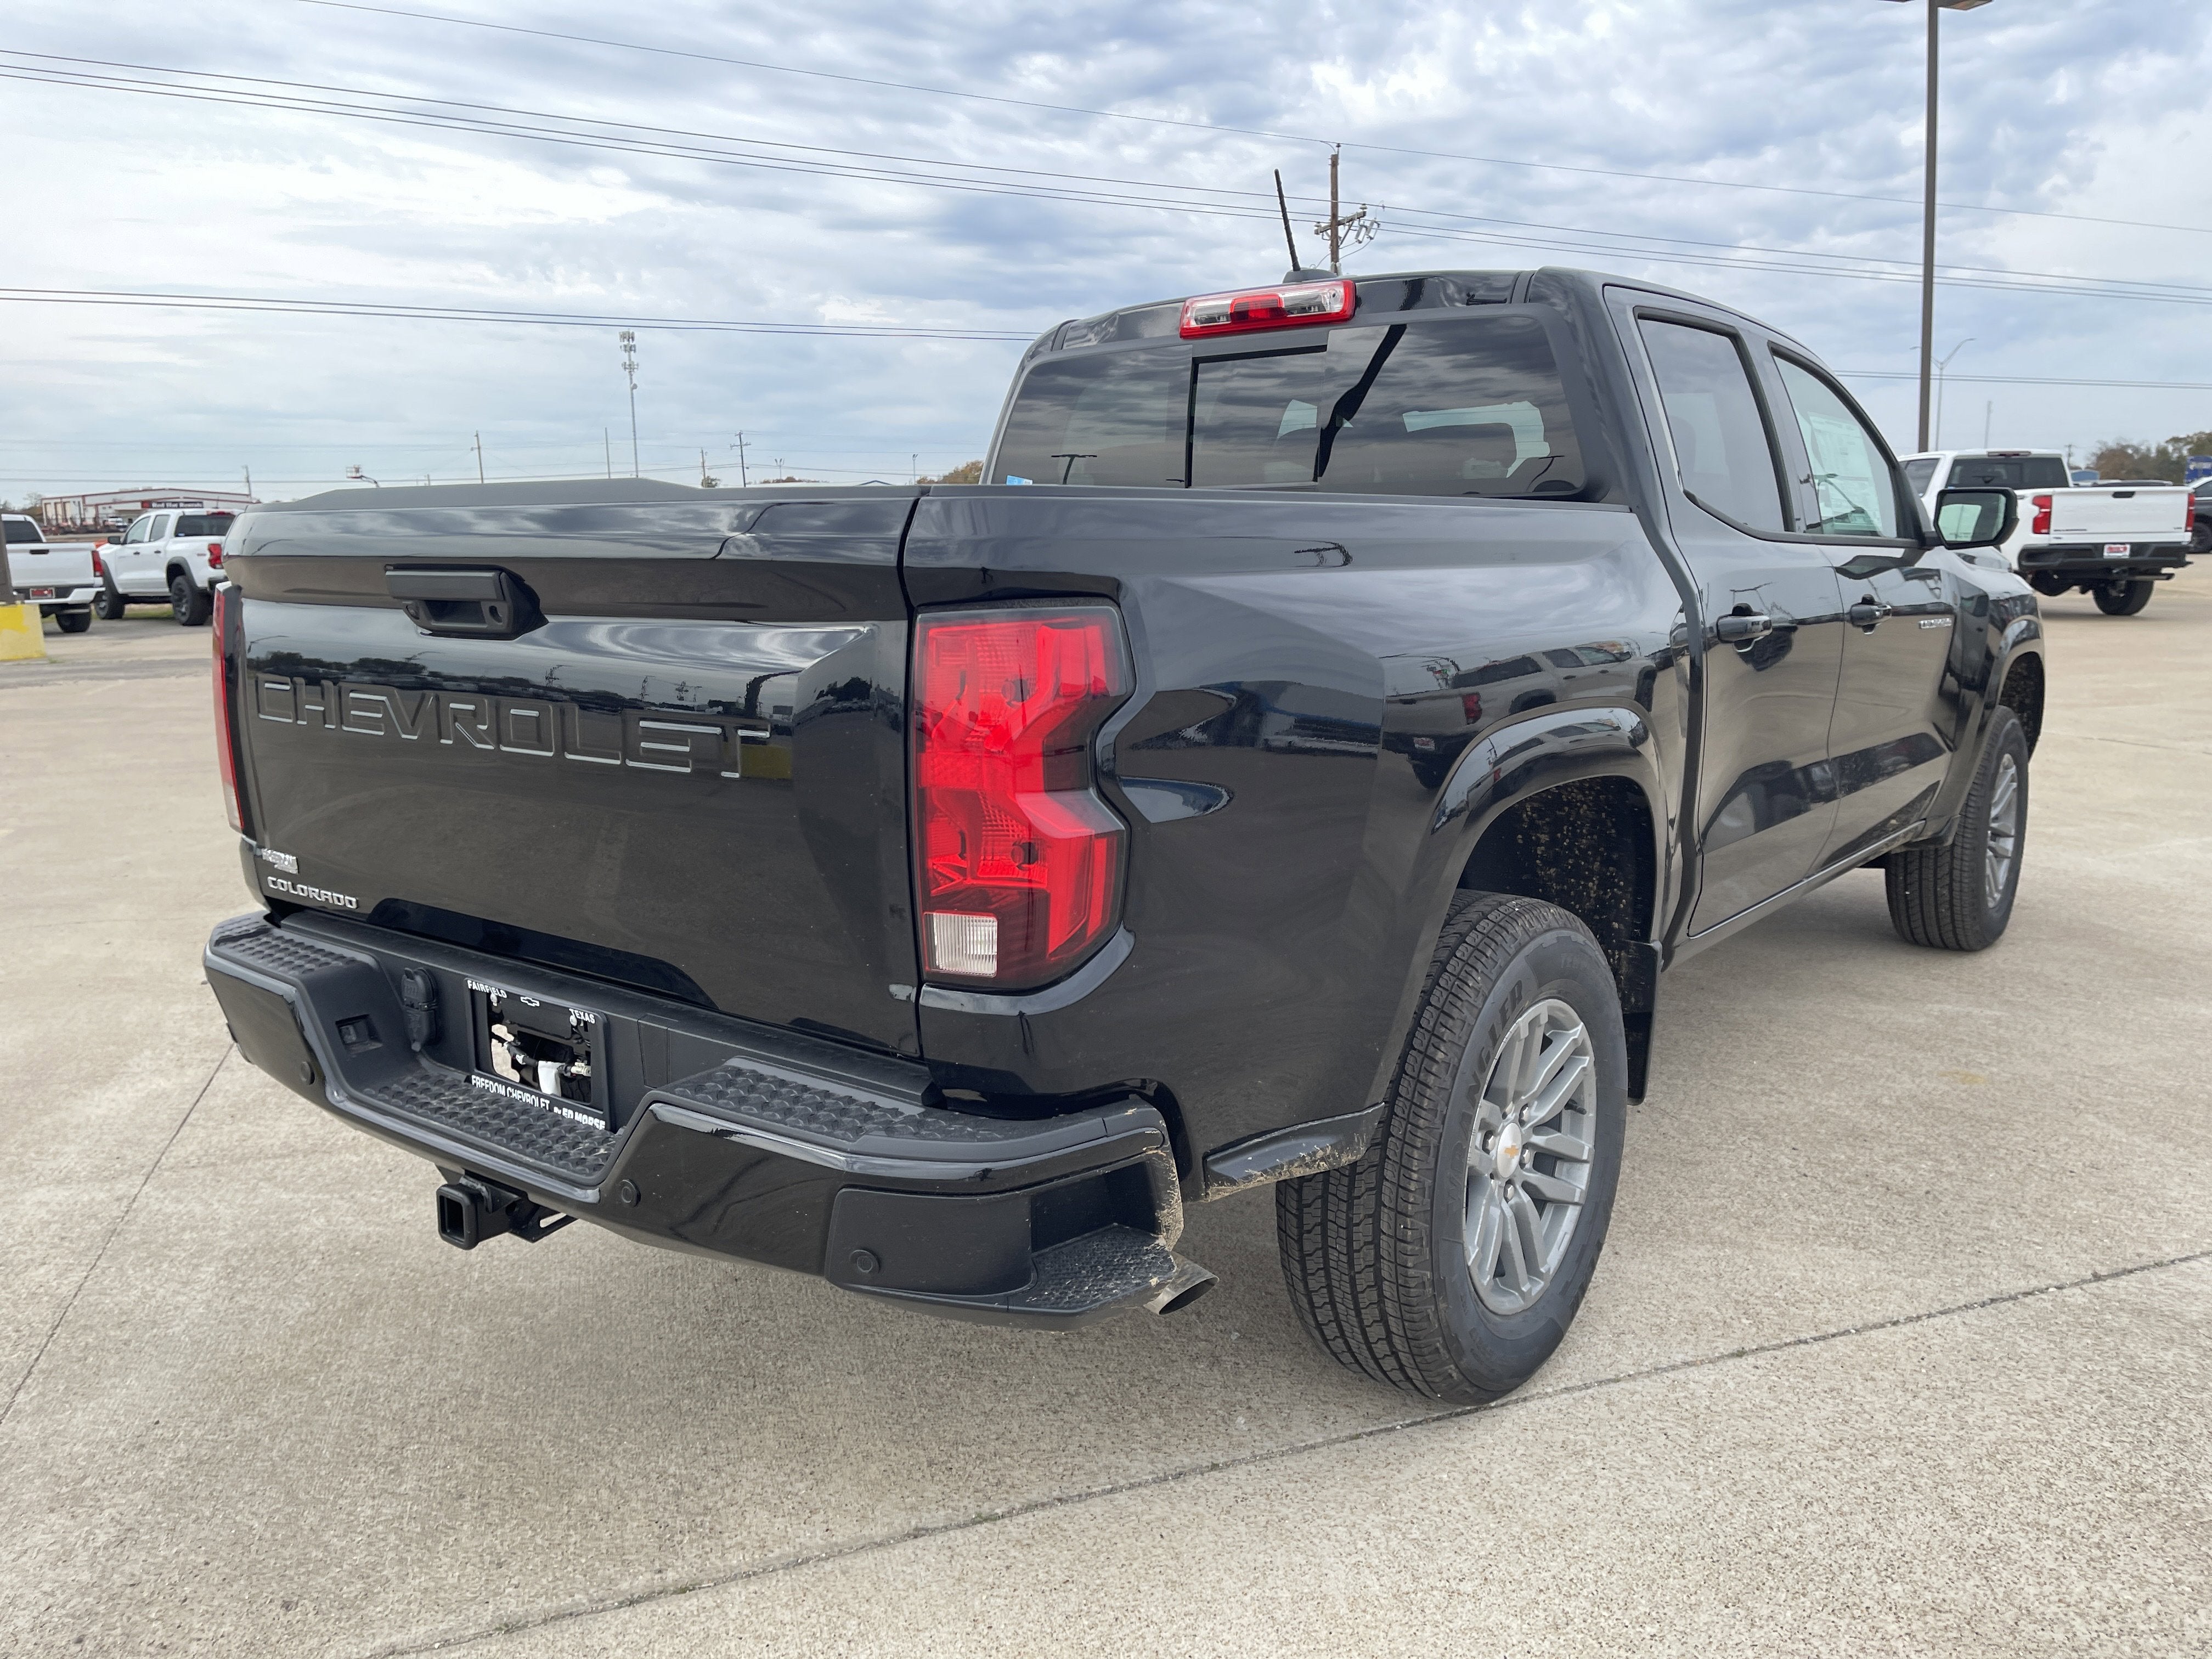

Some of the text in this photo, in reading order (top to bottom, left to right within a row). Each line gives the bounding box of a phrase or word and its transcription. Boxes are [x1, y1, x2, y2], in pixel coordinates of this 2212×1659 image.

[256, 675, 770, 778] CHEVROLET
[267, 876, 358, 909] COLORADO
[467, 980, 507, 998] FAIRFIELD
[569, 1008, 595, 1024] TEXAS
